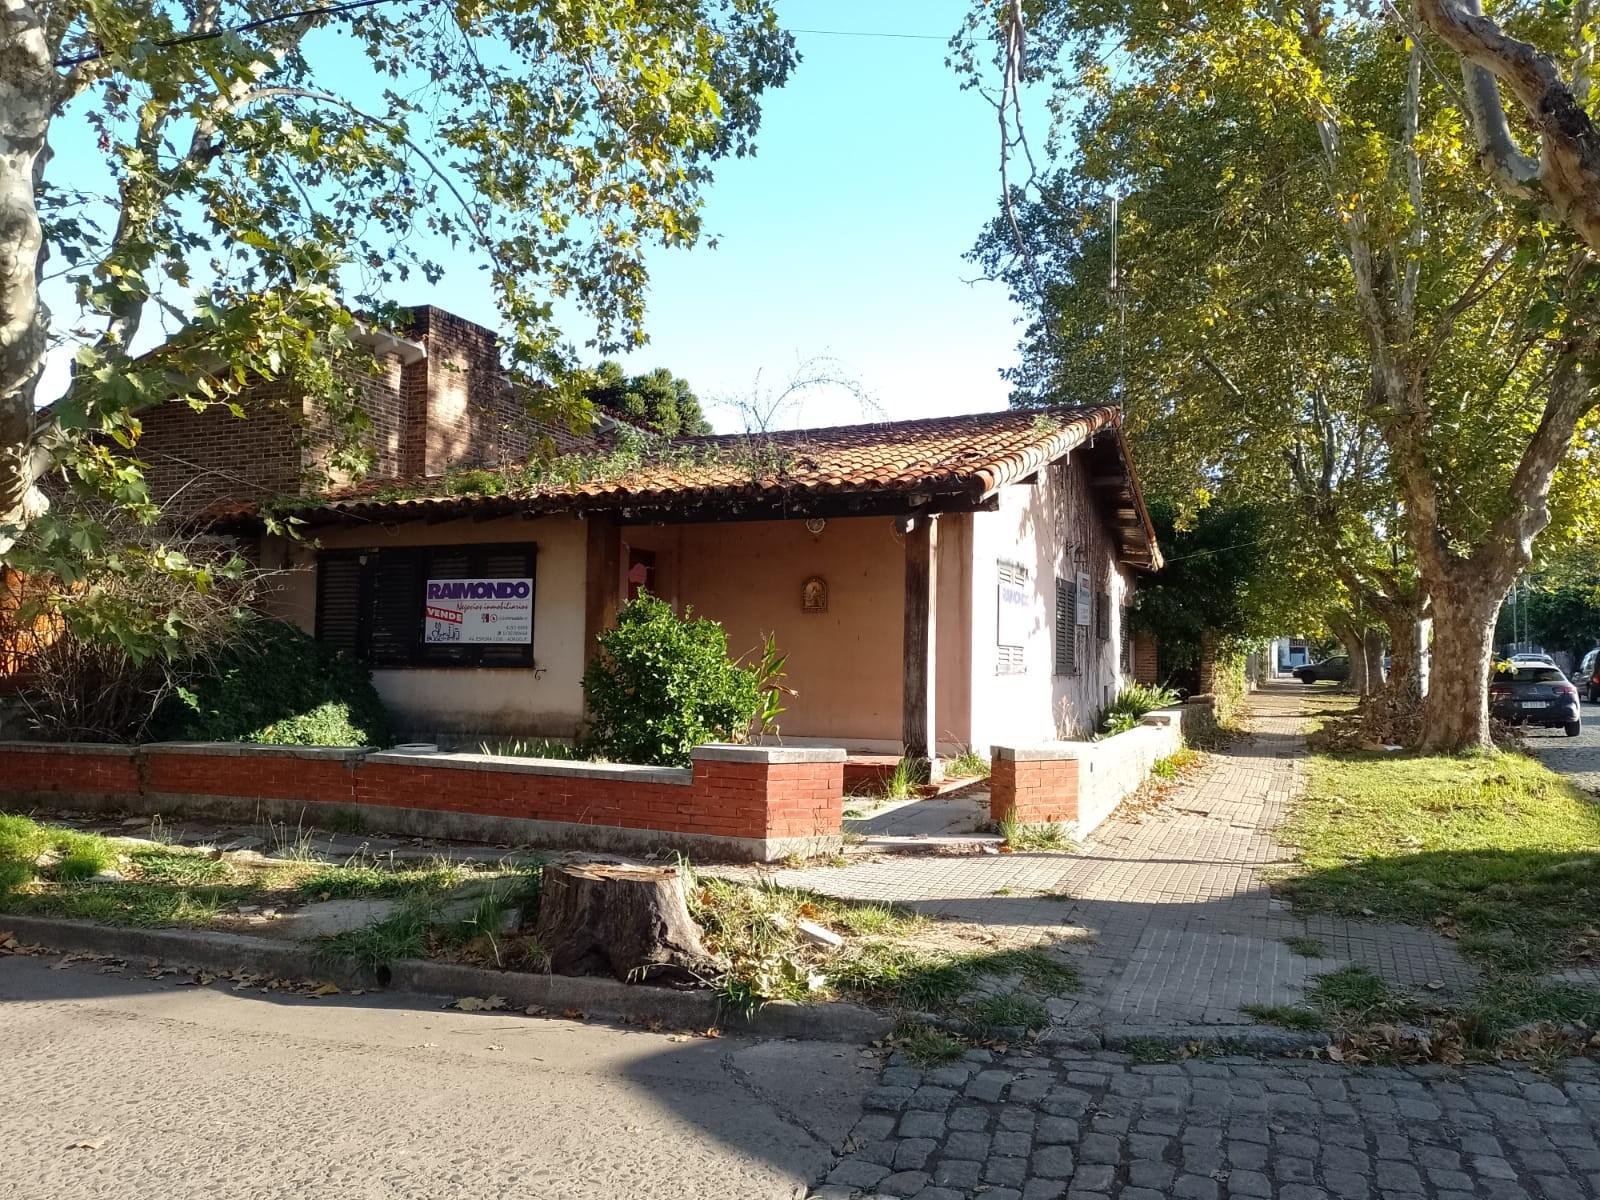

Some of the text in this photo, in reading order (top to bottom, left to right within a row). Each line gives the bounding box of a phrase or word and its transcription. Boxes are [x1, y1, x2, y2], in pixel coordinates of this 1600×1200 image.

[427, 582, 530, 600] RAIMONDO
[427, 607, 462, 621] VENDE
[457, 601, 528, 613] Negocios inmobiliarios
